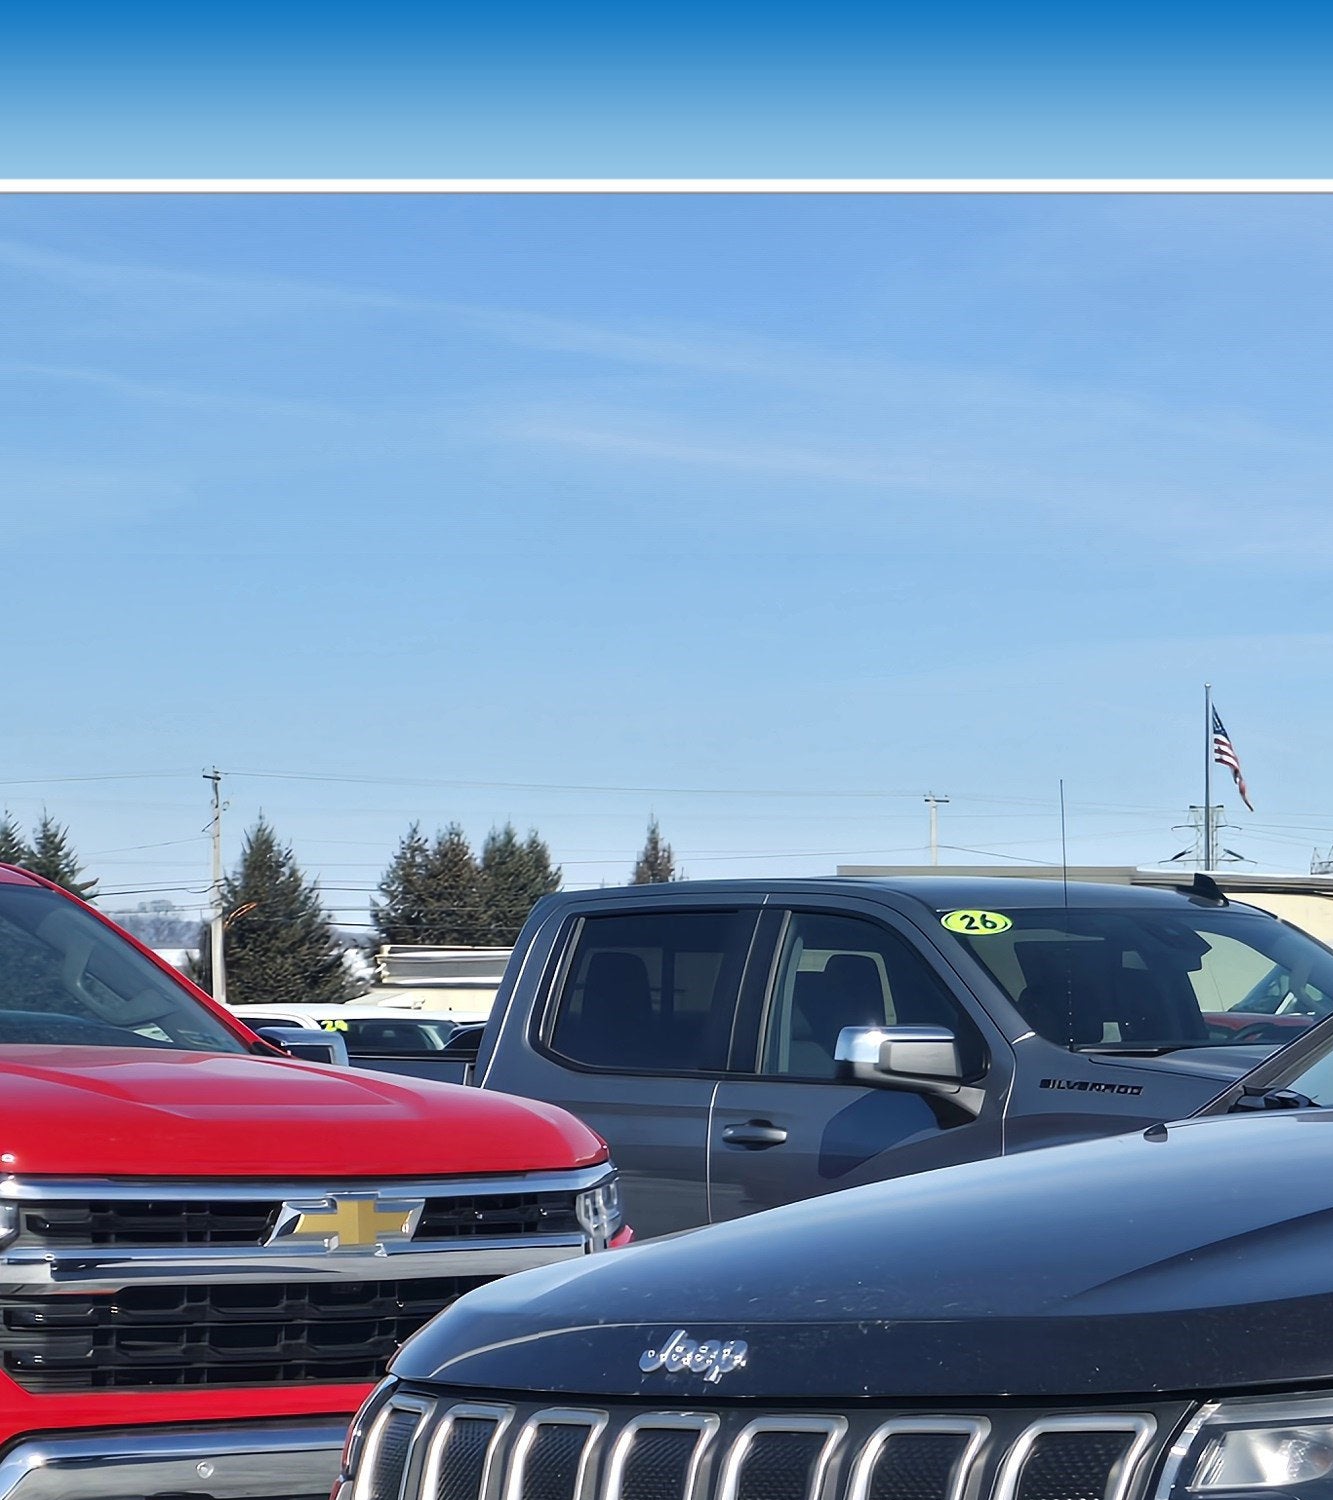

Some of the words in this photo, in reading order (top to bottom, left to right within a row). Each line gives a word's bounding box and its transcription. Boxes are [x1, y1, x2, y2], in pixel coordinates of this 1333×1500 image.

[960, 914, 998, 930] 26
[1040, 1079, 1143, 1095] SILVERADO
[639, 1330, 748, 1384] Jeep
